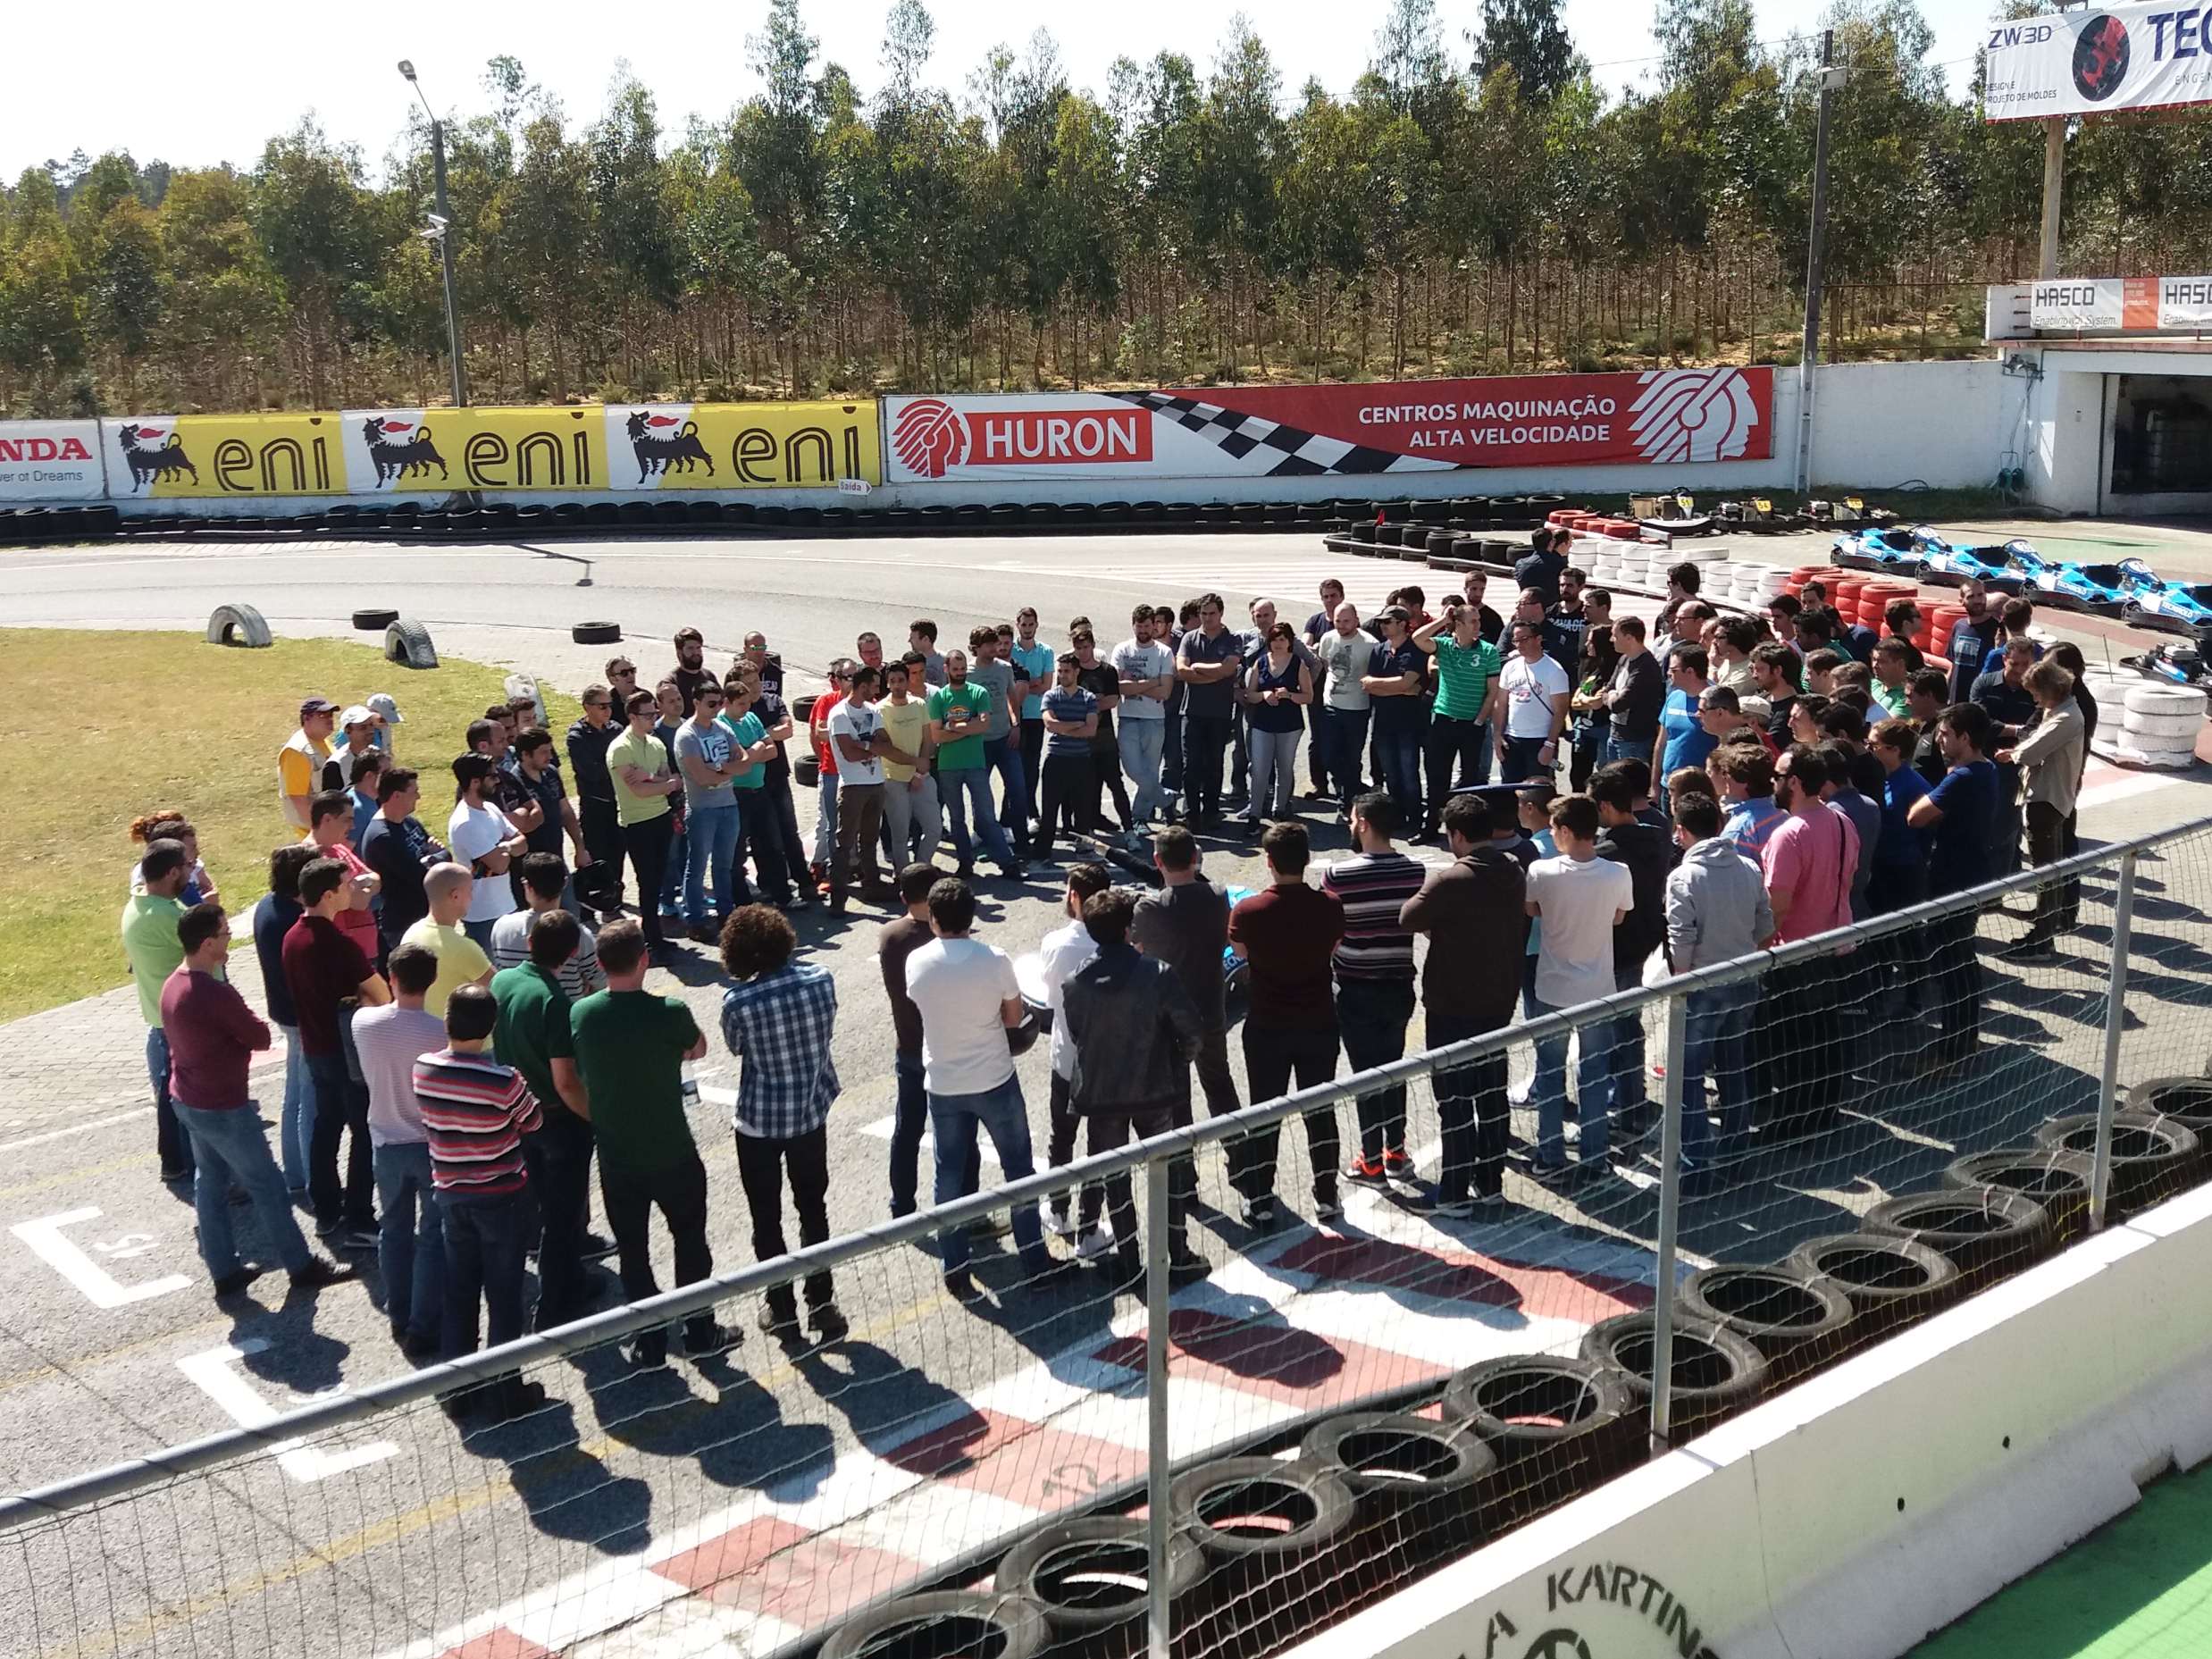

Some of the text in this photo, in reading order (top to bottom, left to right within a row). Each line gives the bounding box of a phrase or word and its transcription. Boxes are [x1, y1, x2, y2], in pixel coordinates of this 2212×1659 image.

[1988, 25, 2052, 48] ZW3D
[2016, 92, 2026, 102] DE
[2027, 89, 2057, 101] MOLDES
[2035, 286, 2095, 307] HASCO
[2165, 284, 2212, 306] HAS
[1359, 394, 1616, 424] CENTROS MAQUINAÇÃO
[732, 405, 860, 483] eni
[985, 416, 1137, 458] HURON
[1409, 424, 1611, 448] ALTA VELOCIDADE
[214, 417, 330, 491] eni
[465, 411, 591, 486] eni
[33, 470, 84, 482] Dreams
[1470, 654, 1480, 667] 3
